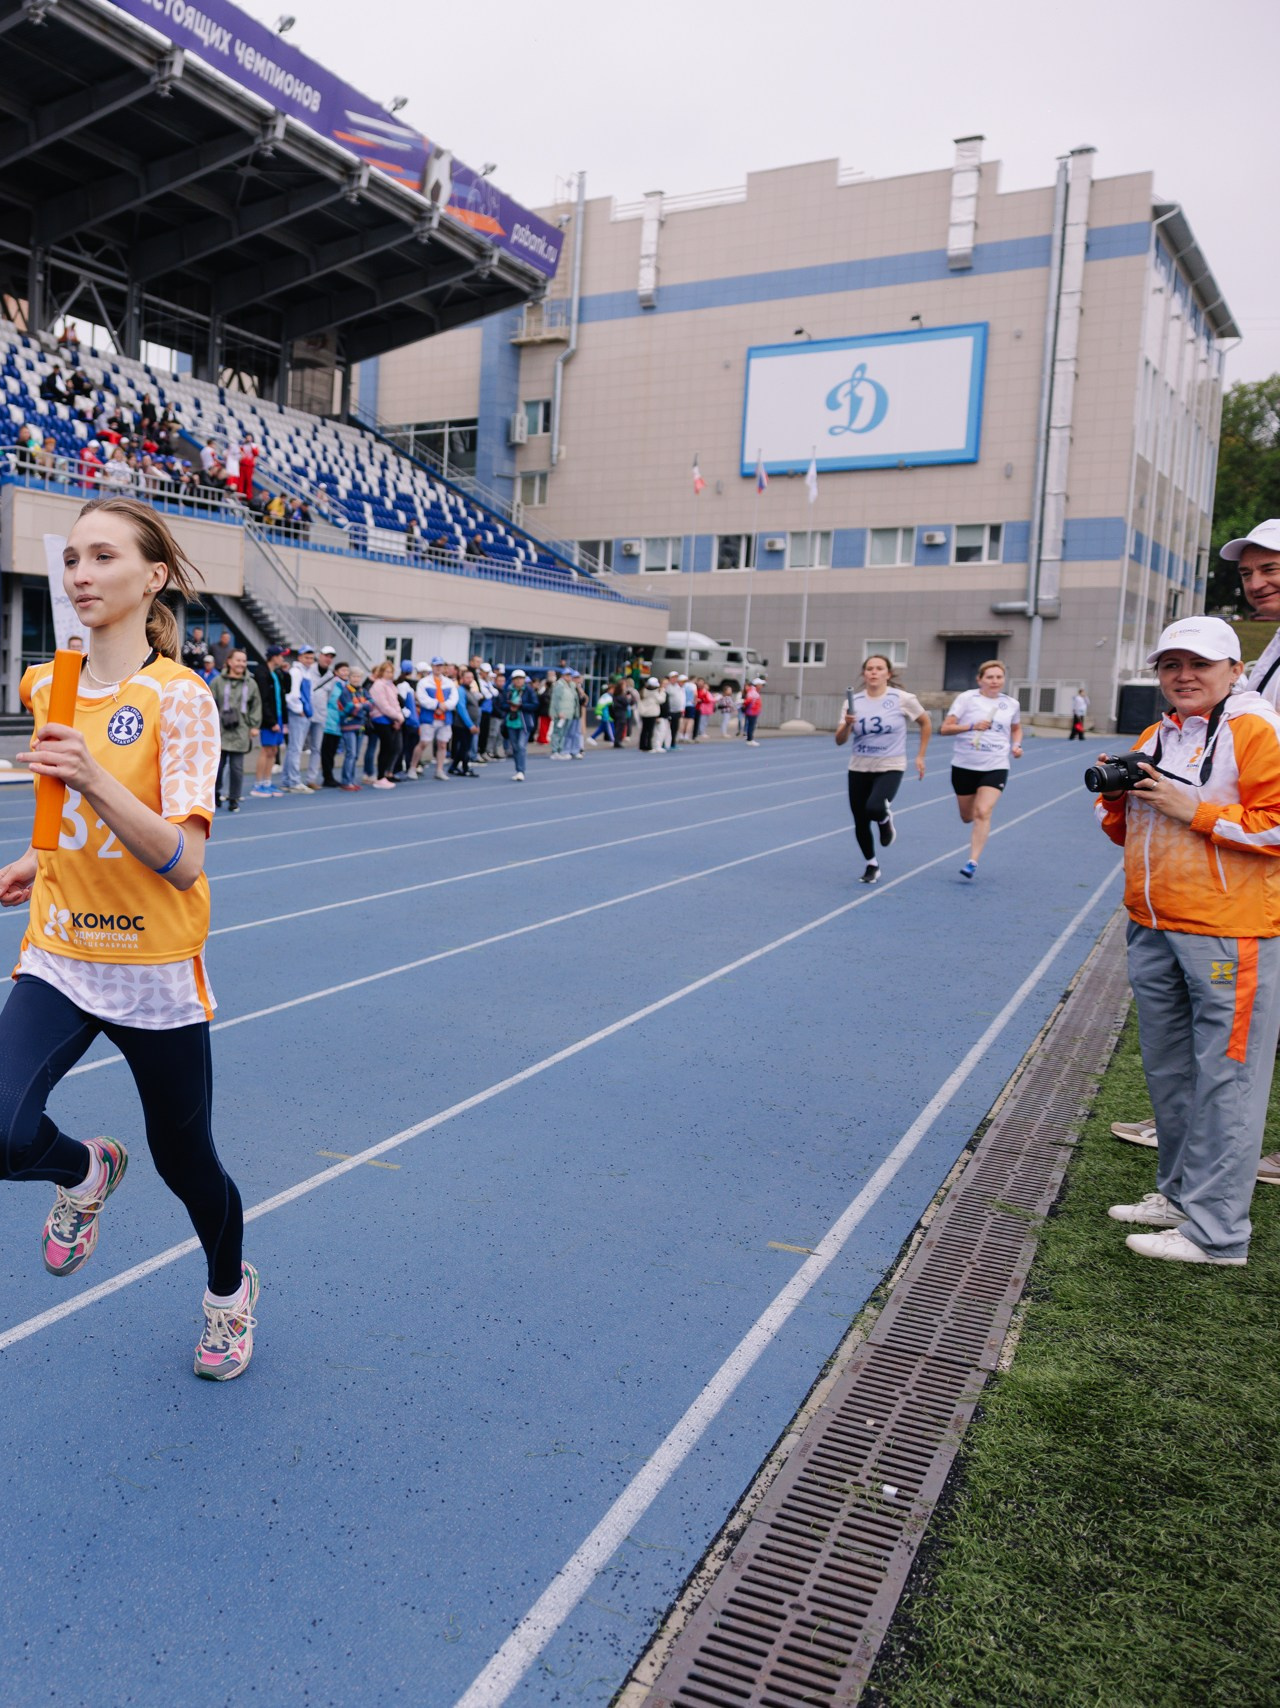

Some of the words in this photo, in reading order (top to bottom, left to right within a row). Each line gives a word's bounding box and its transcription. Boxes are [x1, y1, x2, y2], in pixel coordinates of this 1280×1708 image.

[234, 38, 322, 113] чемпионов
[510, 222, 559, 264] psbank.ru
[71, 912, 146, 932] КОМОС
[73, 929, 139, 942] УДМУРТСКАЯ
